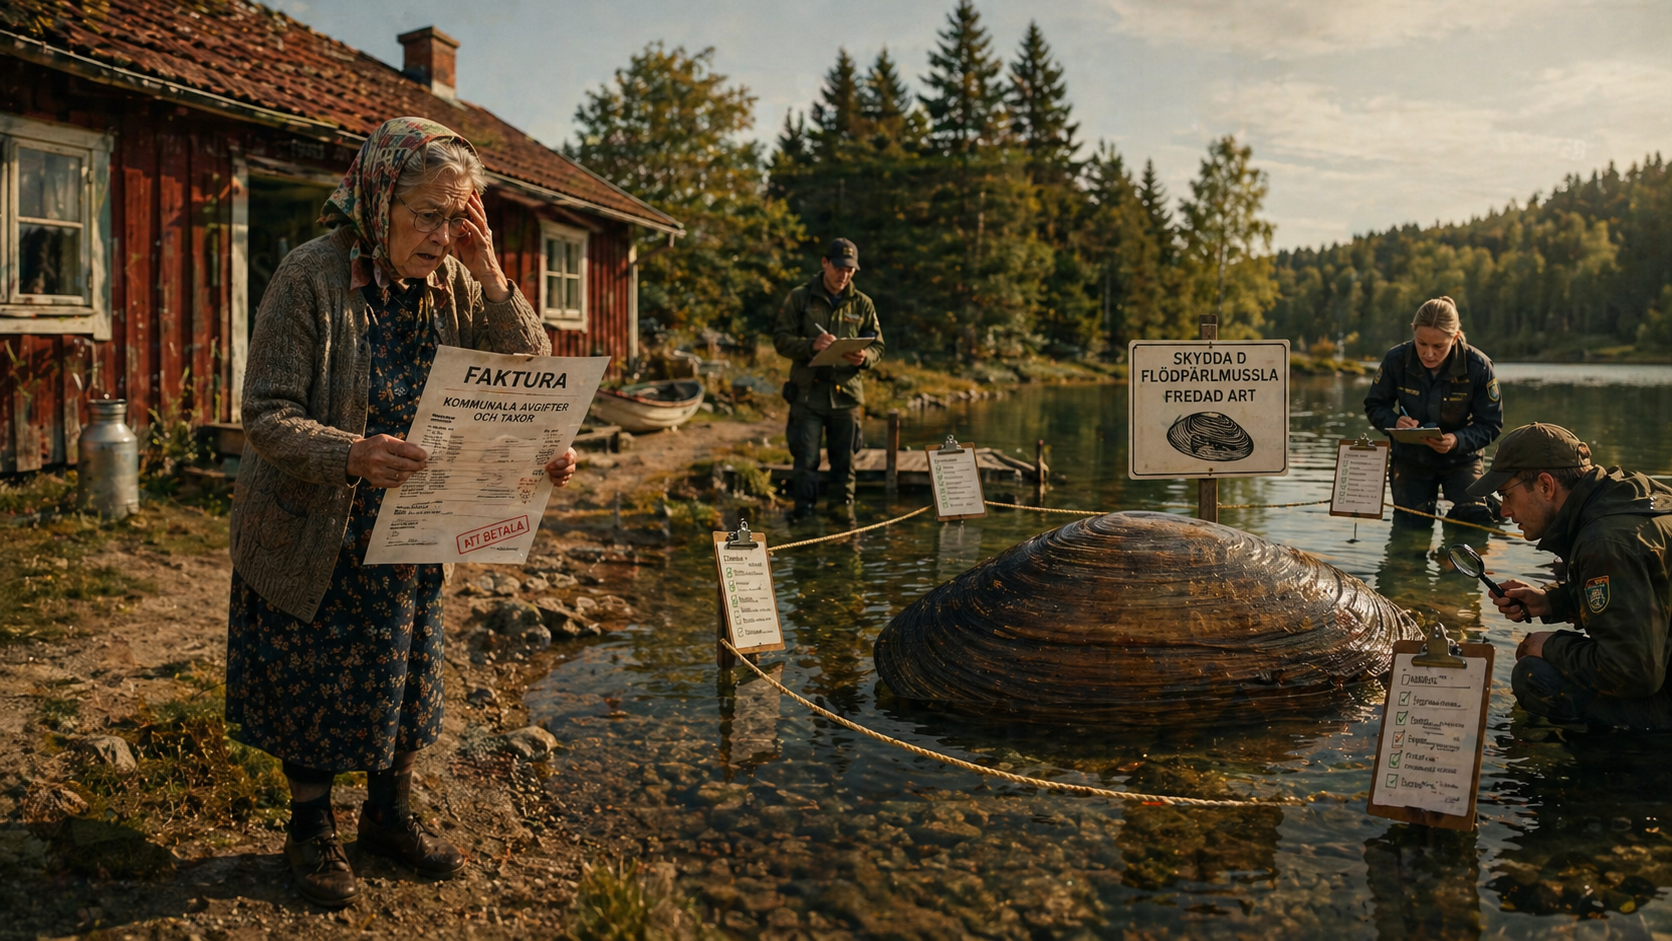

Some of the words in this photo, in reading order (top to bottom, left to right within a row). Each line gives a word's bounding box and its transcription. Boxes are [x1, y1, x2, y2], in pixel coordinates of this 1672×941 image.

[1173, 352, 1233, 365] SKYDDA
[1237, 352, 1246, 364] D
[464, 366, 568, 389] FAKTURA
[1141, 366, 1279, 382] FLÖDPÄRLMUSSLA
[1165, 390, 1223, 403] FREDAD
[1228, 389, 1256, 402] ART
[443, 397, 517, 411] KOMMUNALA
[519, 403, 569, 412] AVGIFTER
[473, 413, 497, 422] OCH
[501, 414, 535, 423] TAXOR
[484, 521, 525, 541] BETALA
